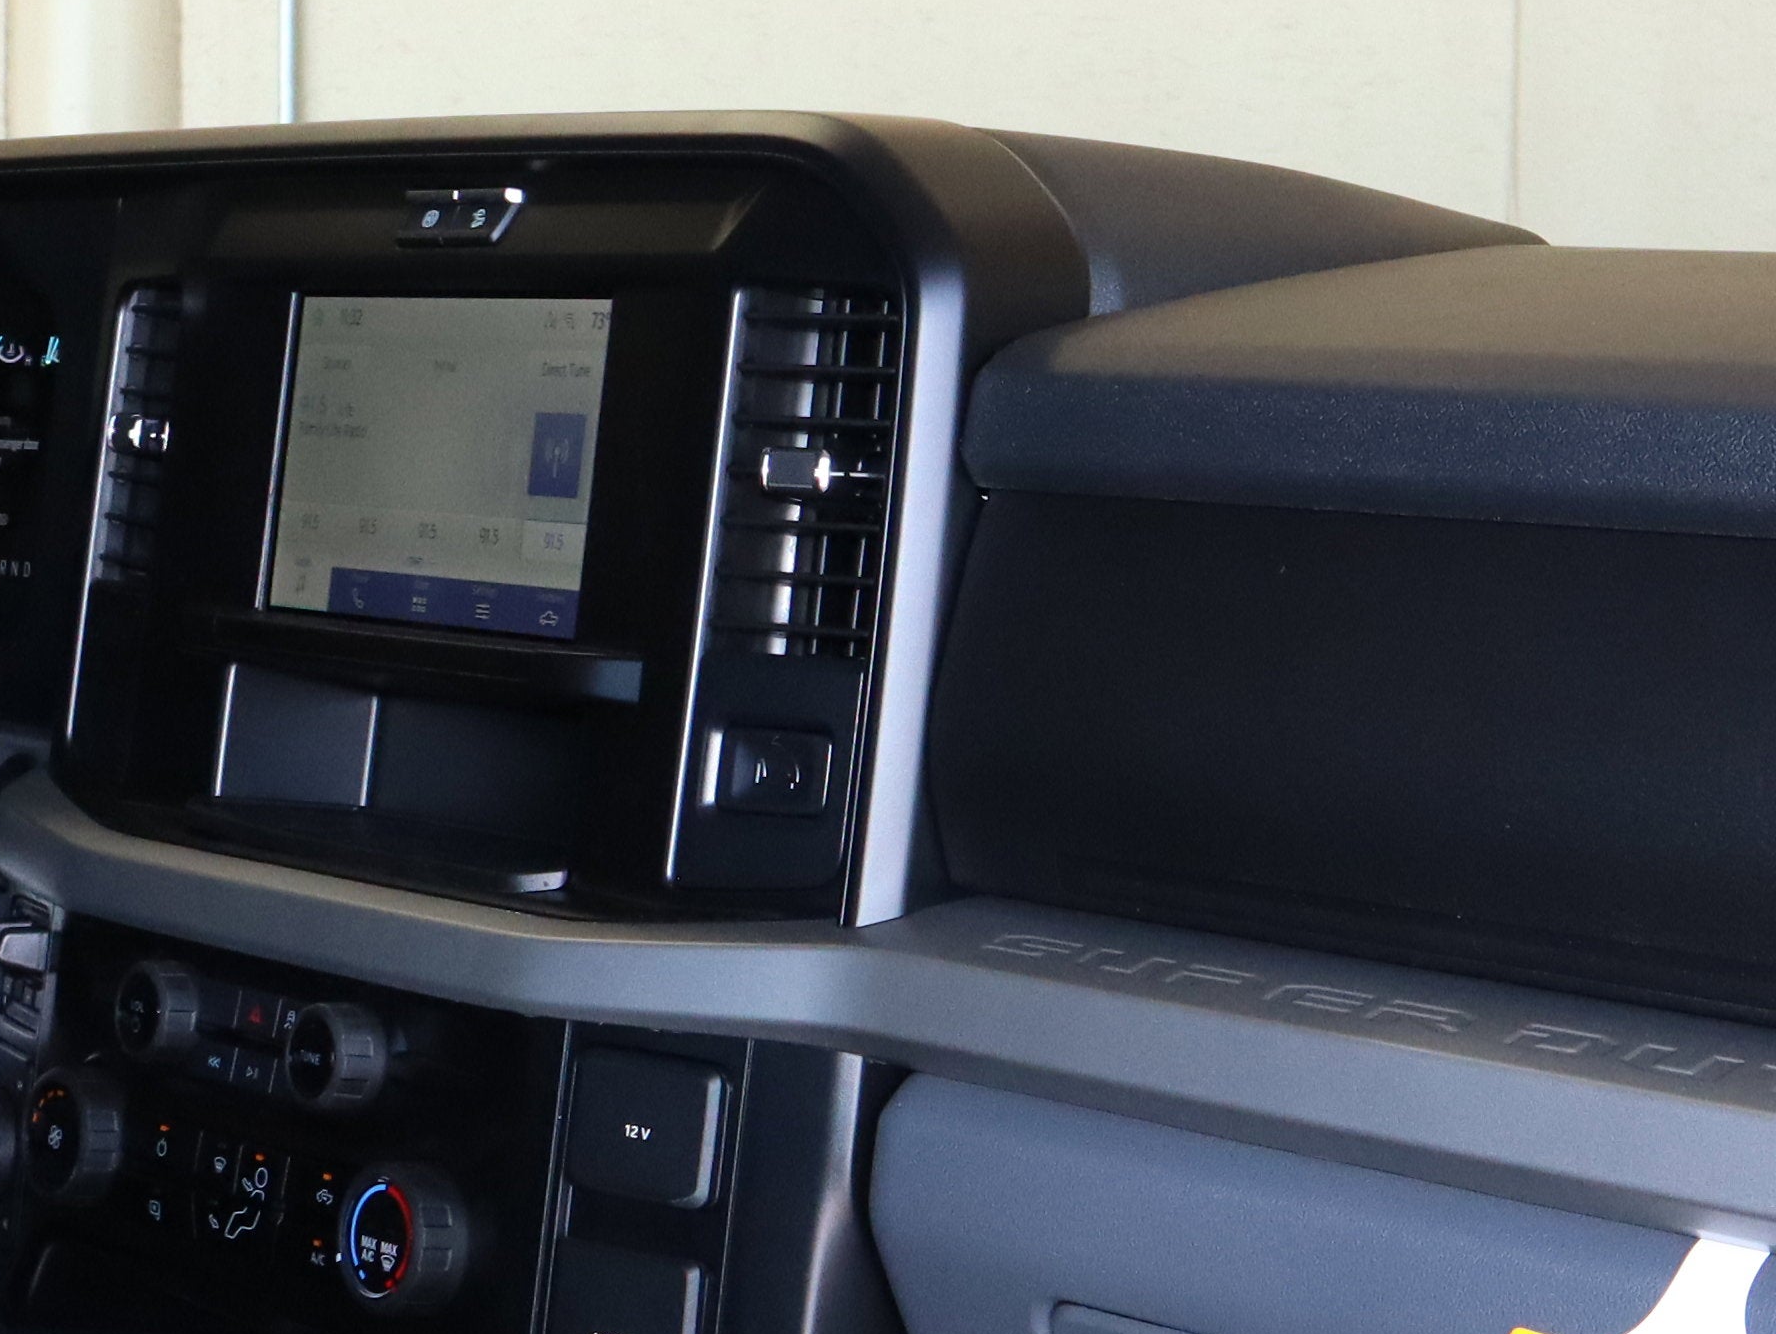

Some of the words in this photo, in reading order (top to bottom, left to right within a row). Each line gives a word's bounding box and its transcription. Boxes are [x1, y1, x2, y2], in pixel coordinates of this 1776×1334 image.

[981, 933, 1476, 1034] SUPER
[624, 1124, 639, 1139] 12
[641, 1127, 652, 1141] V
[361, 1234, 378, 1250] MAX
[380, 1241, 399, 1257] MAX
